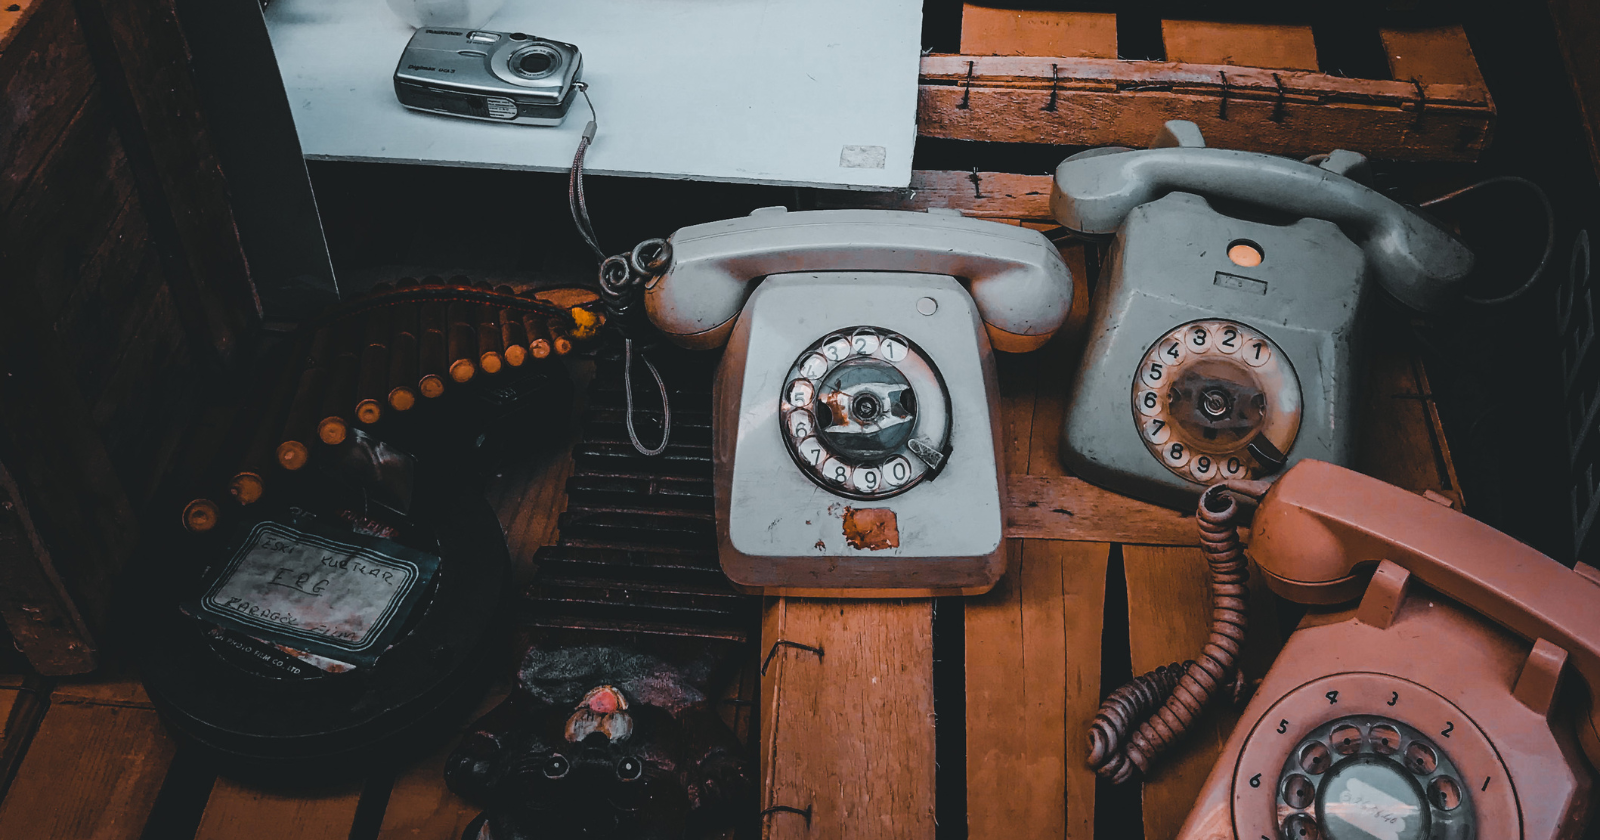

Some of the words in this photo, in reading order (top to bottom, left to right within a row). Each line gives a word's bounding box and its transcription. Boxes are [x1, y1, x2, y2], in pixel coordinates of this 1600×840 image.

[1193, 329, 1207, 346] 3
[1222, 329, 1237, 348] 2
[827, 345, 839, 361] 3
[854, 338, 867, 355] 2
[887, 342, 894, 359] 1
[1167, 341, 1180, 359] 4
[1252, 342, 1262, 360] 1
[806, 364, 817, 379] 4
[1149, 363, 1163, 380] 5
[1143, 391, 1158, 409] 6
[795, 422, 808, 438] 6
[1151, 419, 1166, 437] 7
[810, 448, 821, 466] 7
[1170, 443, 1184, 460] 8
[892, 462, 905, 481] 0
[1197, 456, 1211, 474] 9
[1227, 456, 1240, 475] 0
[835, 466, 847, 483] 8
[865, 471, 877, 490] 9
[1325, 690, 1339, 705] 4
[1387, 691, 1399, 706] 3
[1276, 719, 1289, 735] 5
[1440, 721, 1454, 738] 2
[1249, 773, 1262, 789] 6
[1481, 776, 1491, 792] 1
